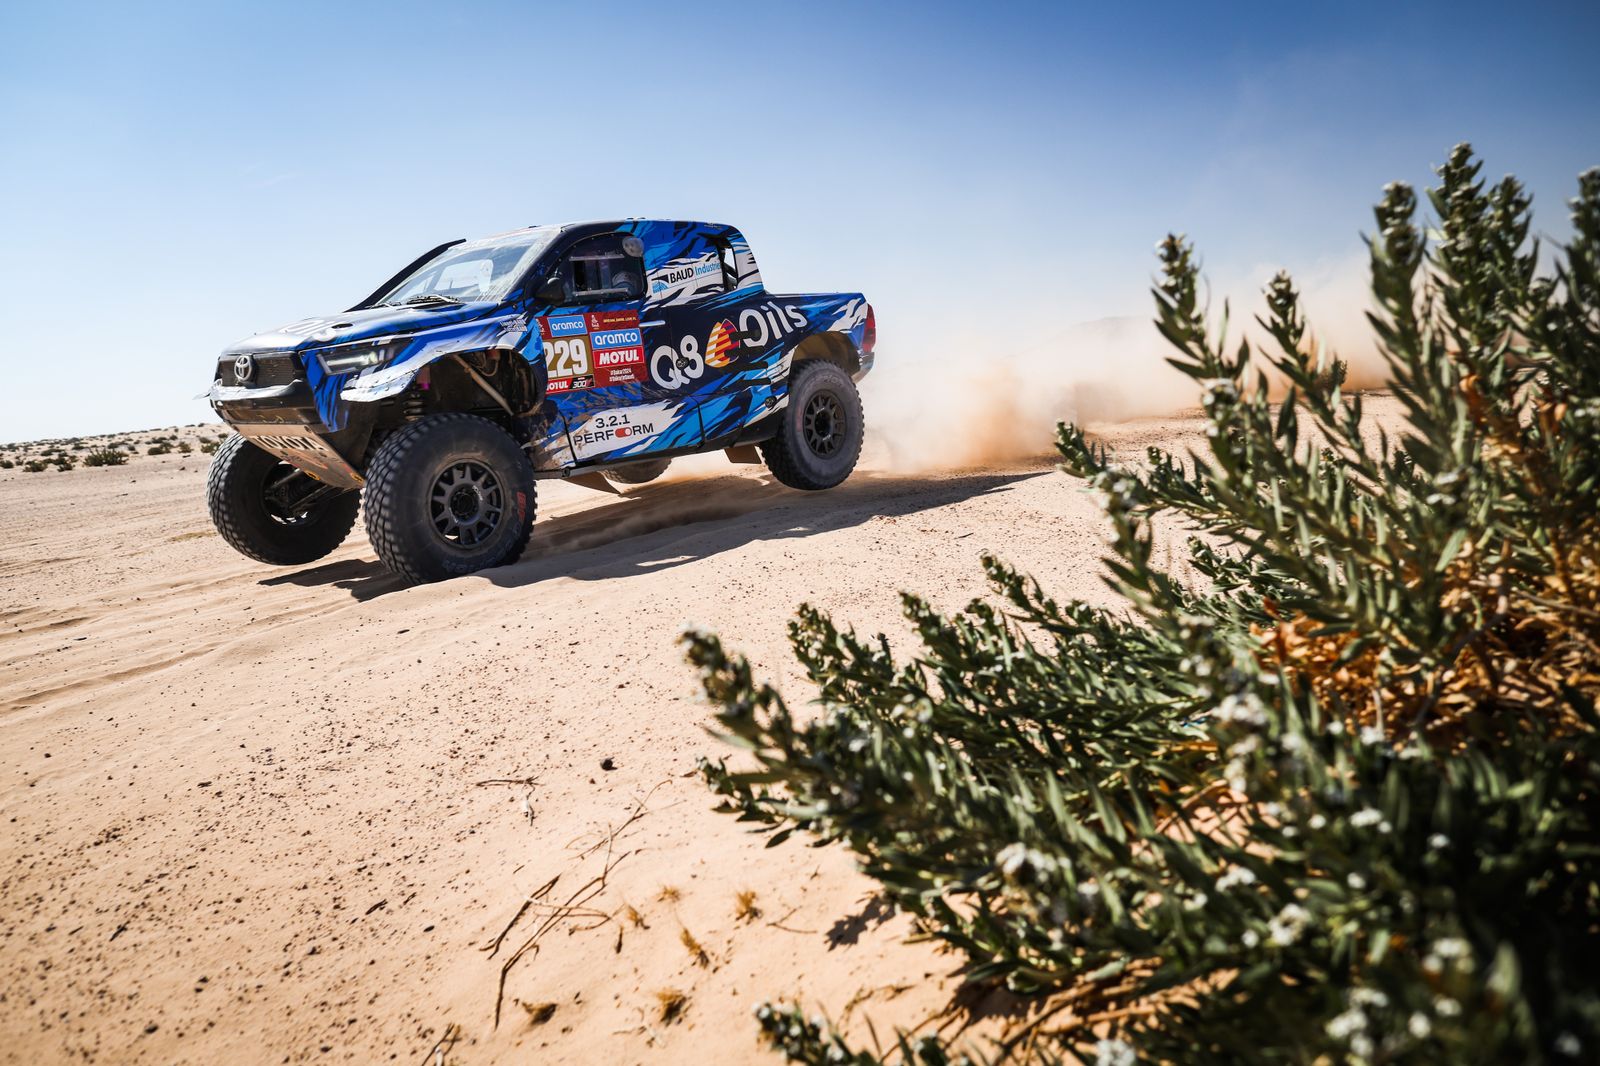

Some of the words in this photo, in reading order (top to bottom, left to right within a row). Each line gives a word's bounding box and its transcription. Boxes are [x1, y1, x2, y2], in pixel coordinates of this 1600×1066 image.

[670, 267, 694, 283] BAUD
[552, 321, 584, 331] aramco
[595, 332, 638, 346] aramco
[651, 335, 704, 389] Q8
[739, 301, 808, 347] Oils
[543, 339, 588, 378] 229
[599, 349, 640, 365] MOTUL
[547, 380, 569, 391] OTUL
[595, 414, 630, 428] 3.2.1
